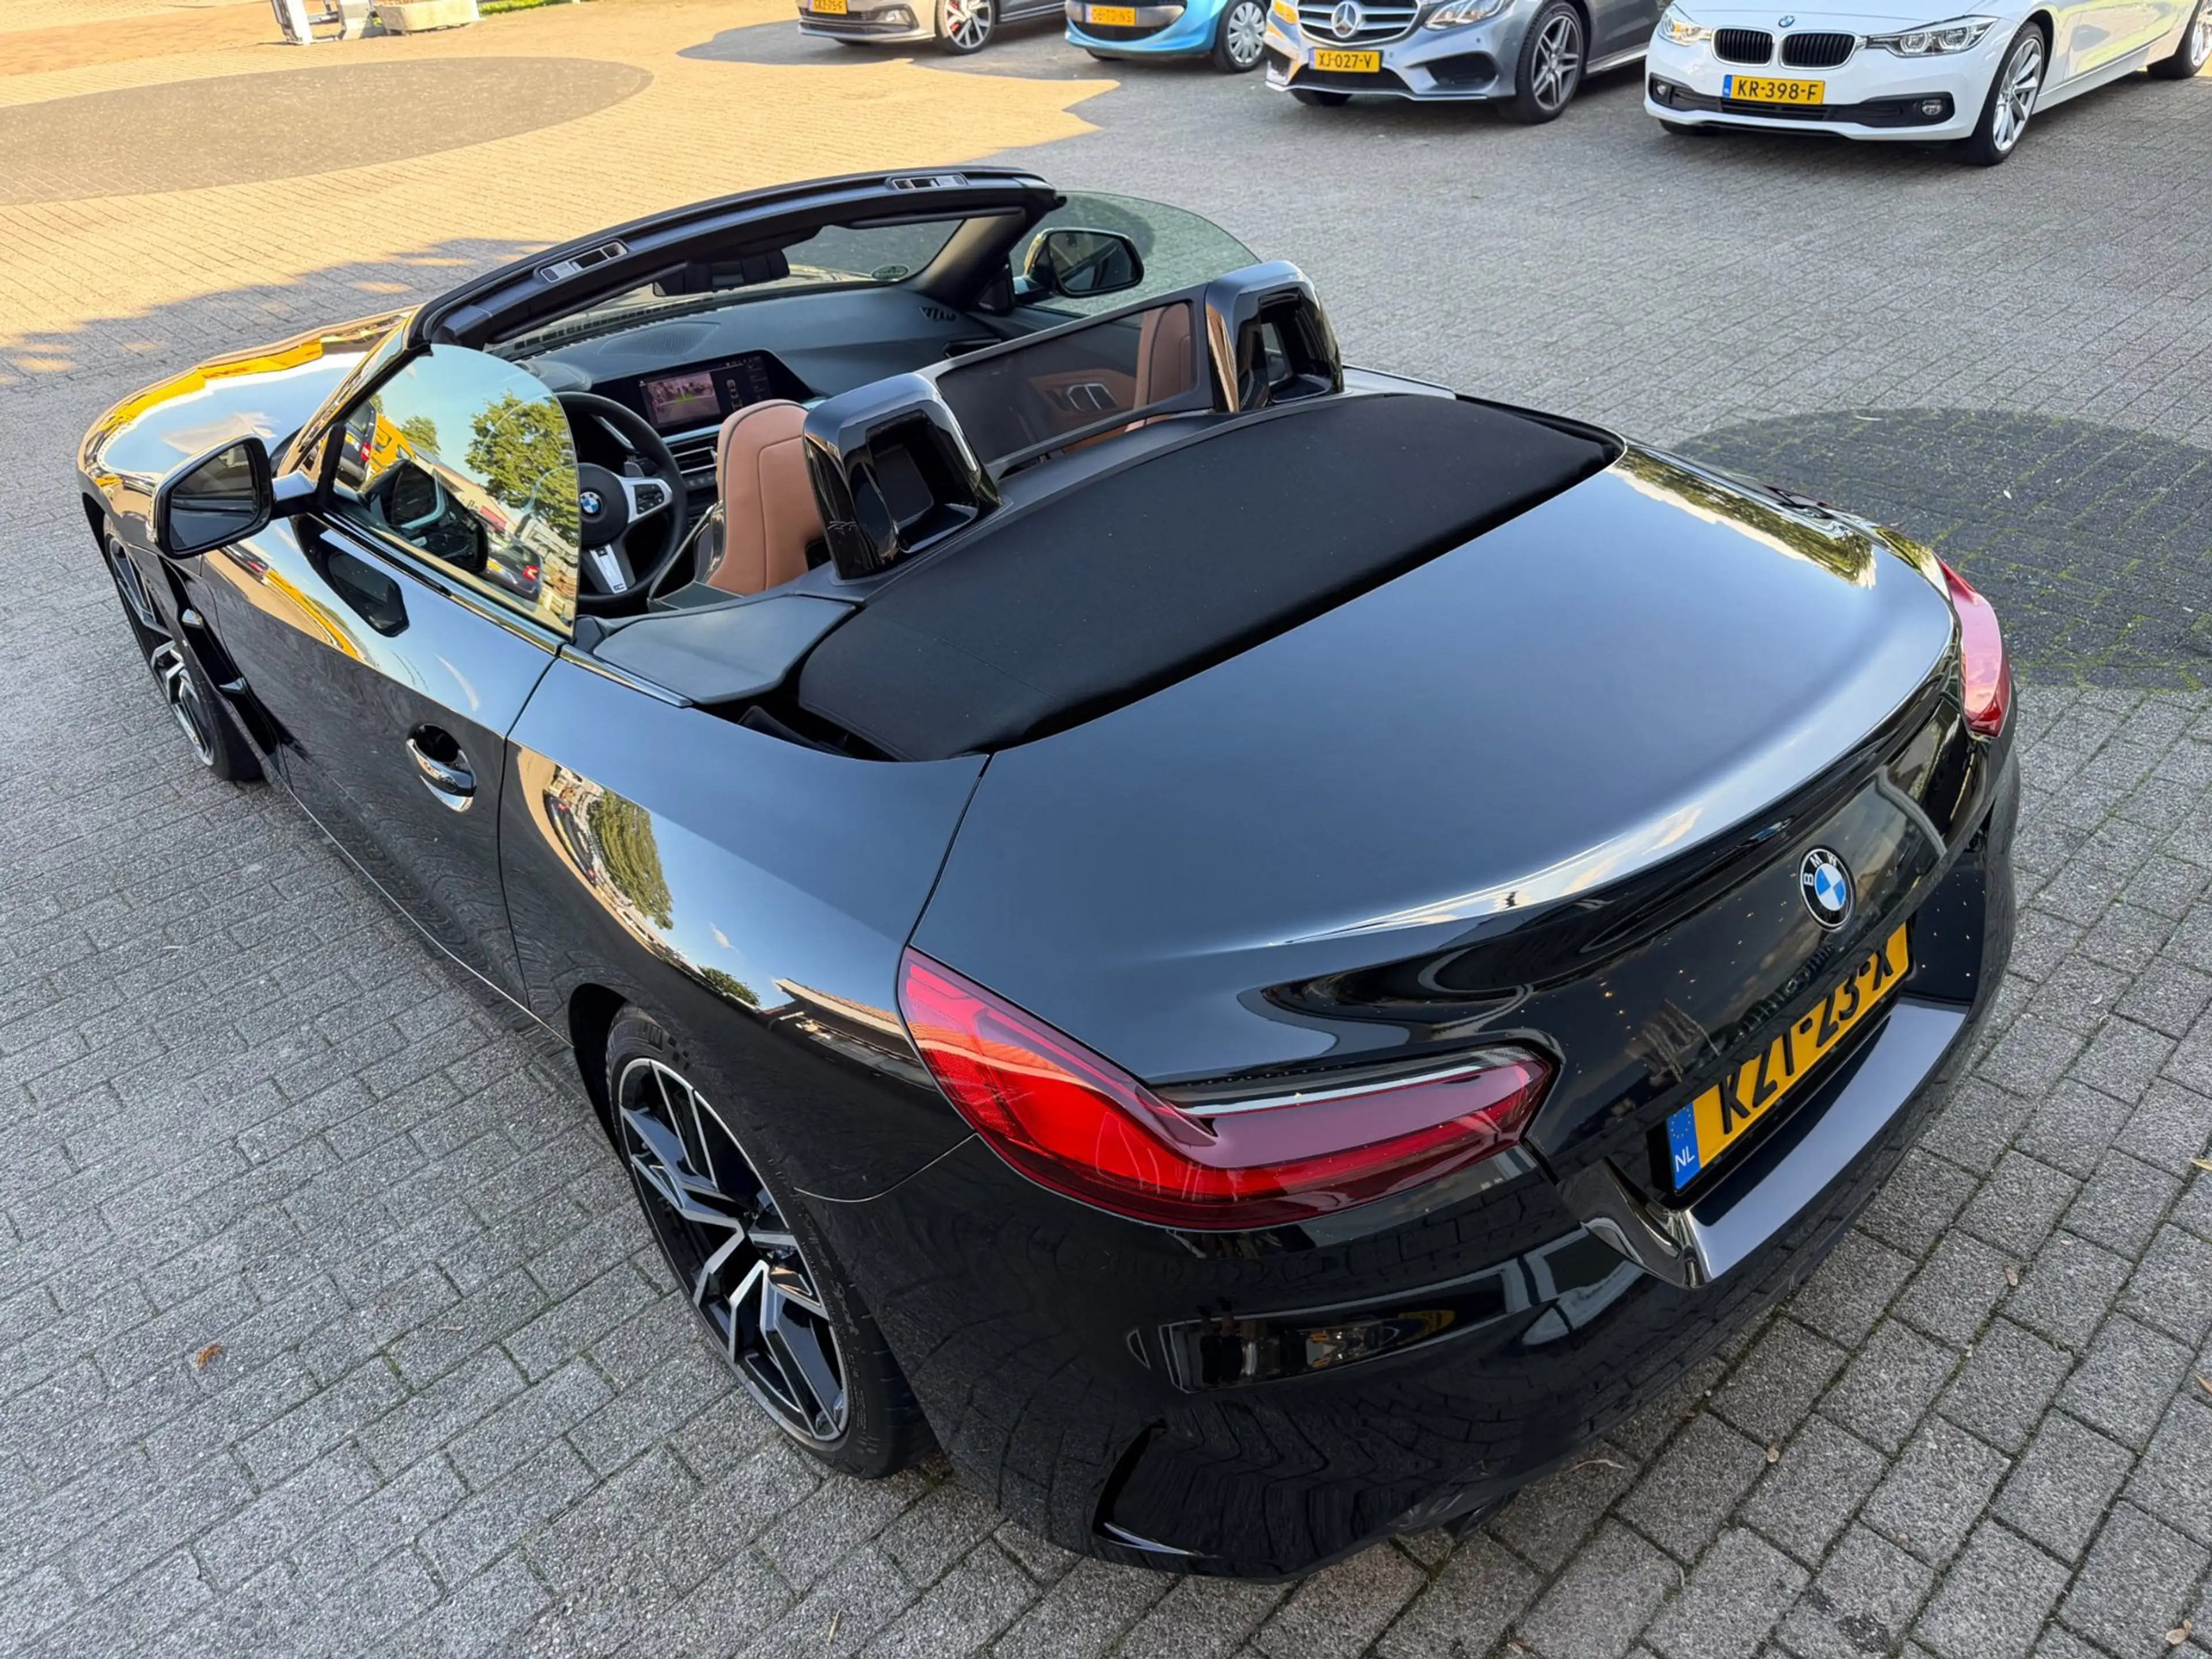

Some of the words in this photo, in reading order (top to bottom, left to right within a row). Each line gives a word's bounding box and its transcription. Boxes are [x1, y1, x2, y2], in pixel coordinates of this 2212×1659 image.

[1318, 52, 1372, 69] XJ-027-V
[1737, 79, 1819, 101] KR-398-F
[1804, 851, 1839, 887] BMW
[1675, 1145, 1695, 1173] NL
